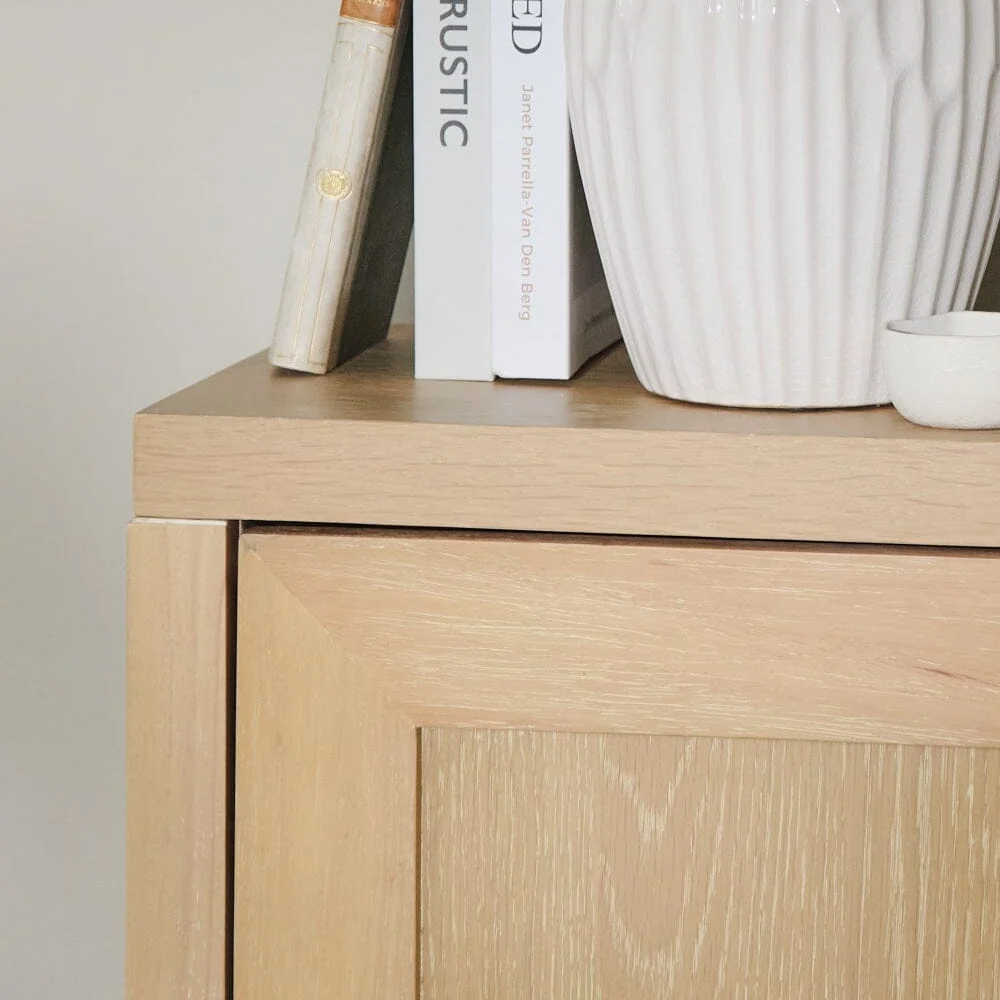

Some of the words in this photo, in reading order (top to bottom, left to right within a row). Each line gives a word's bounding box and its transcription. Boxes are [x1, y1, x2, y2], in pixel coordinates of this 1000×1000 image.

[519, 84, 534, 132] Janet
[519, 136, 534, 238] Parrella-Van
[519, 244, 534, 278] Den
[517, 282, 534, 321] Berg
